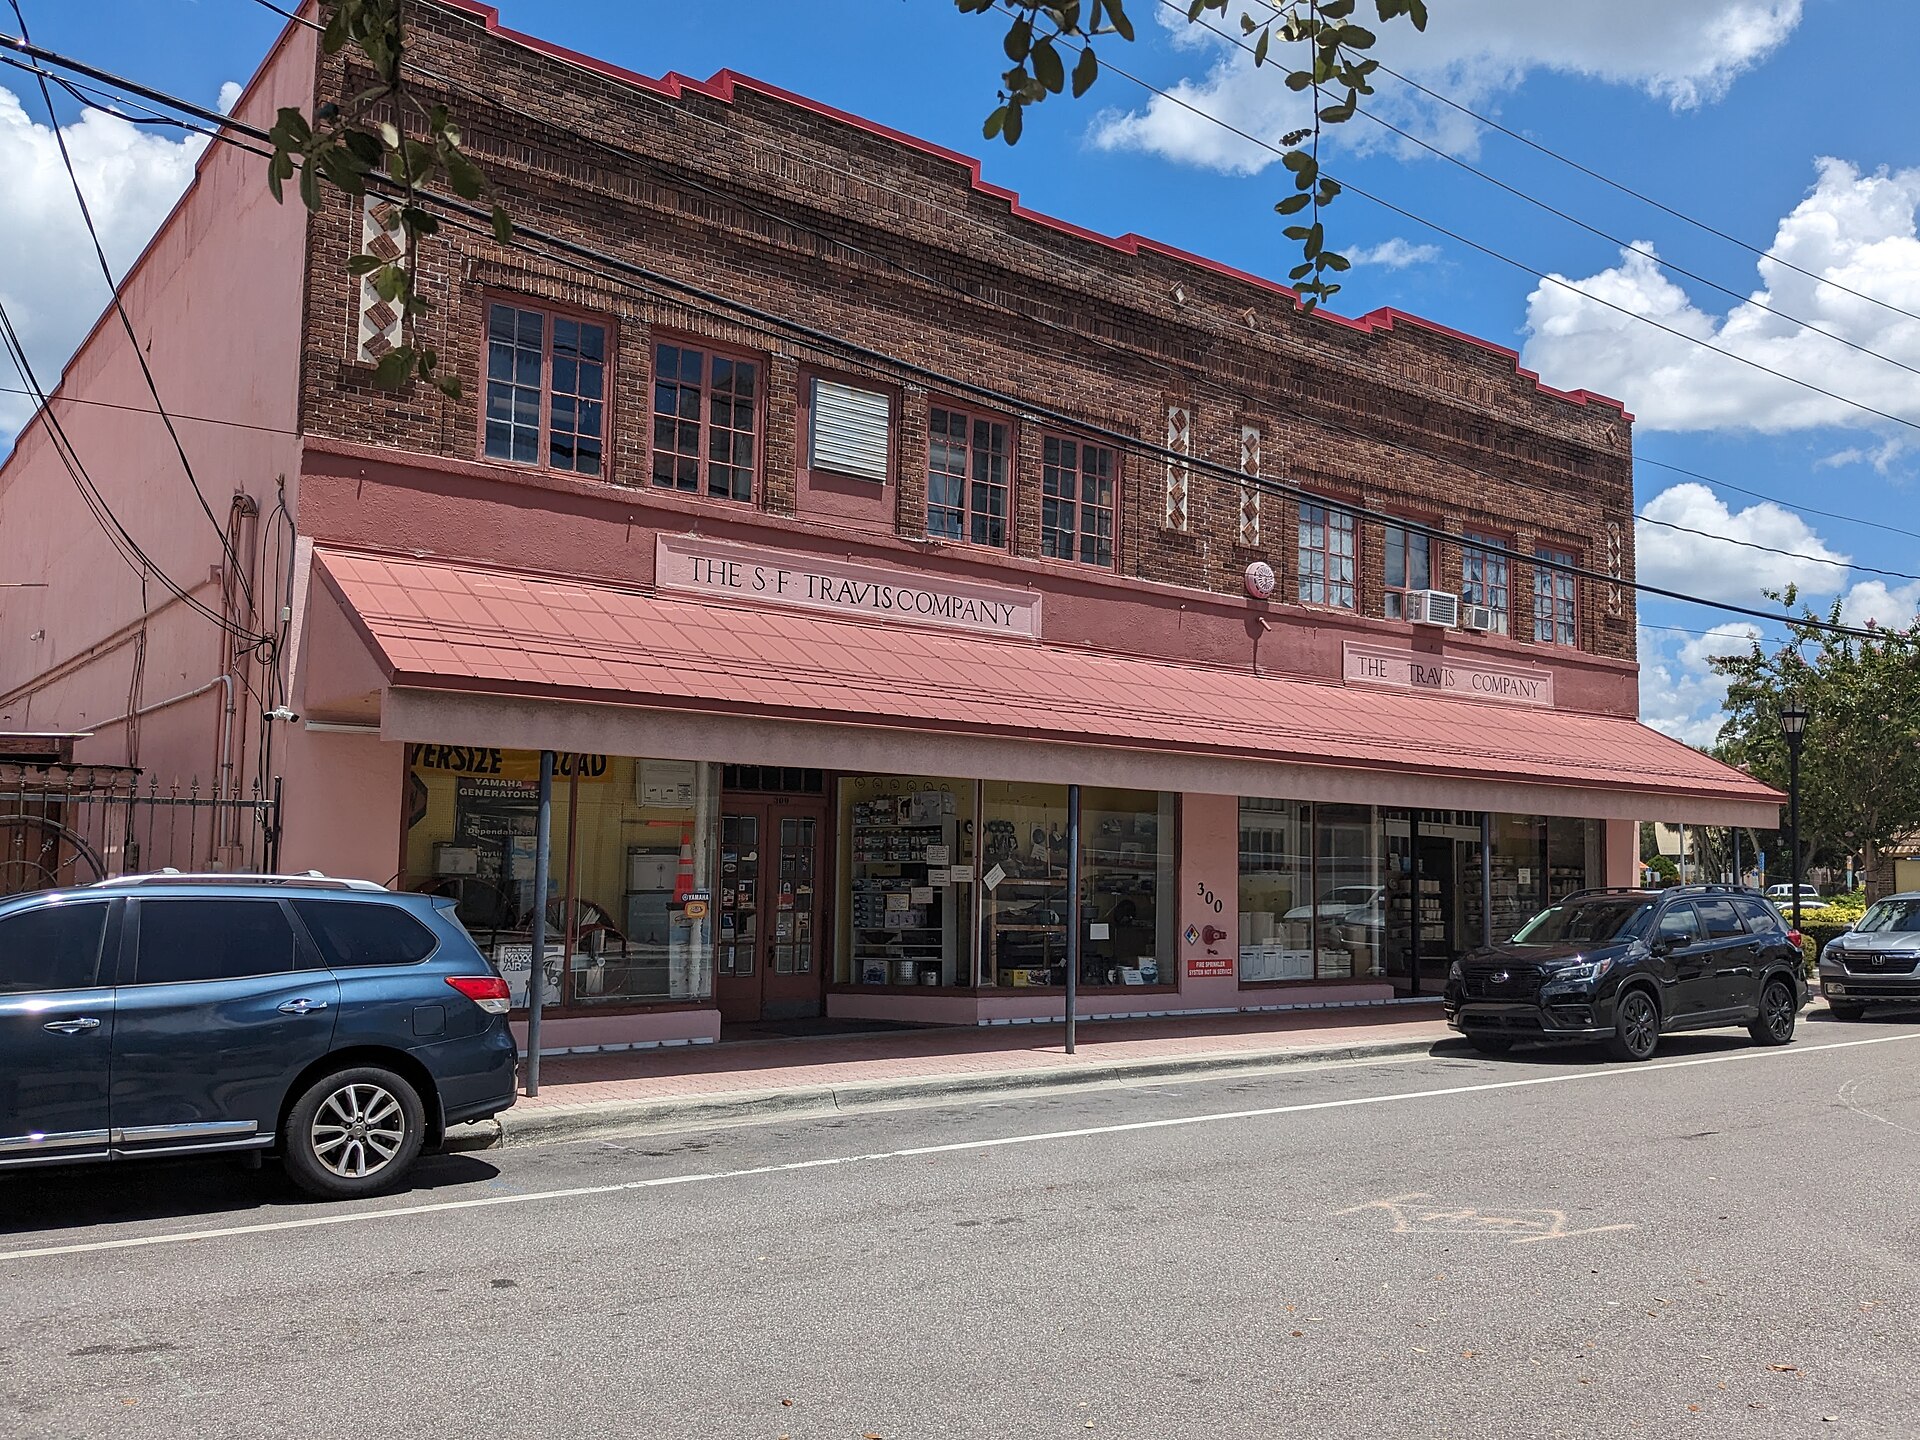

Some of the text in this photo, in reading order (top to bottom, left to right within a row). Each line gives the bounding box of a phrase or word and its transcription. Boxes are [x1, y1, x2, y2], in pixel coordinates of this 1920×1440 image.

[688, 556, 742, 588] THE
[804, 573, 892, 609] TRAVIS
[896, 590, 1016, 627] COMPANY
[1358, 657, 1539, 698] THE TRAVIS COMPANY
[475, 778, 523, 788] YAMAHA
[688, 893, 709, 901] YAMAHA
[1197, 882, 1222, 913] 300
[504, 963, 522, 971] AIR
